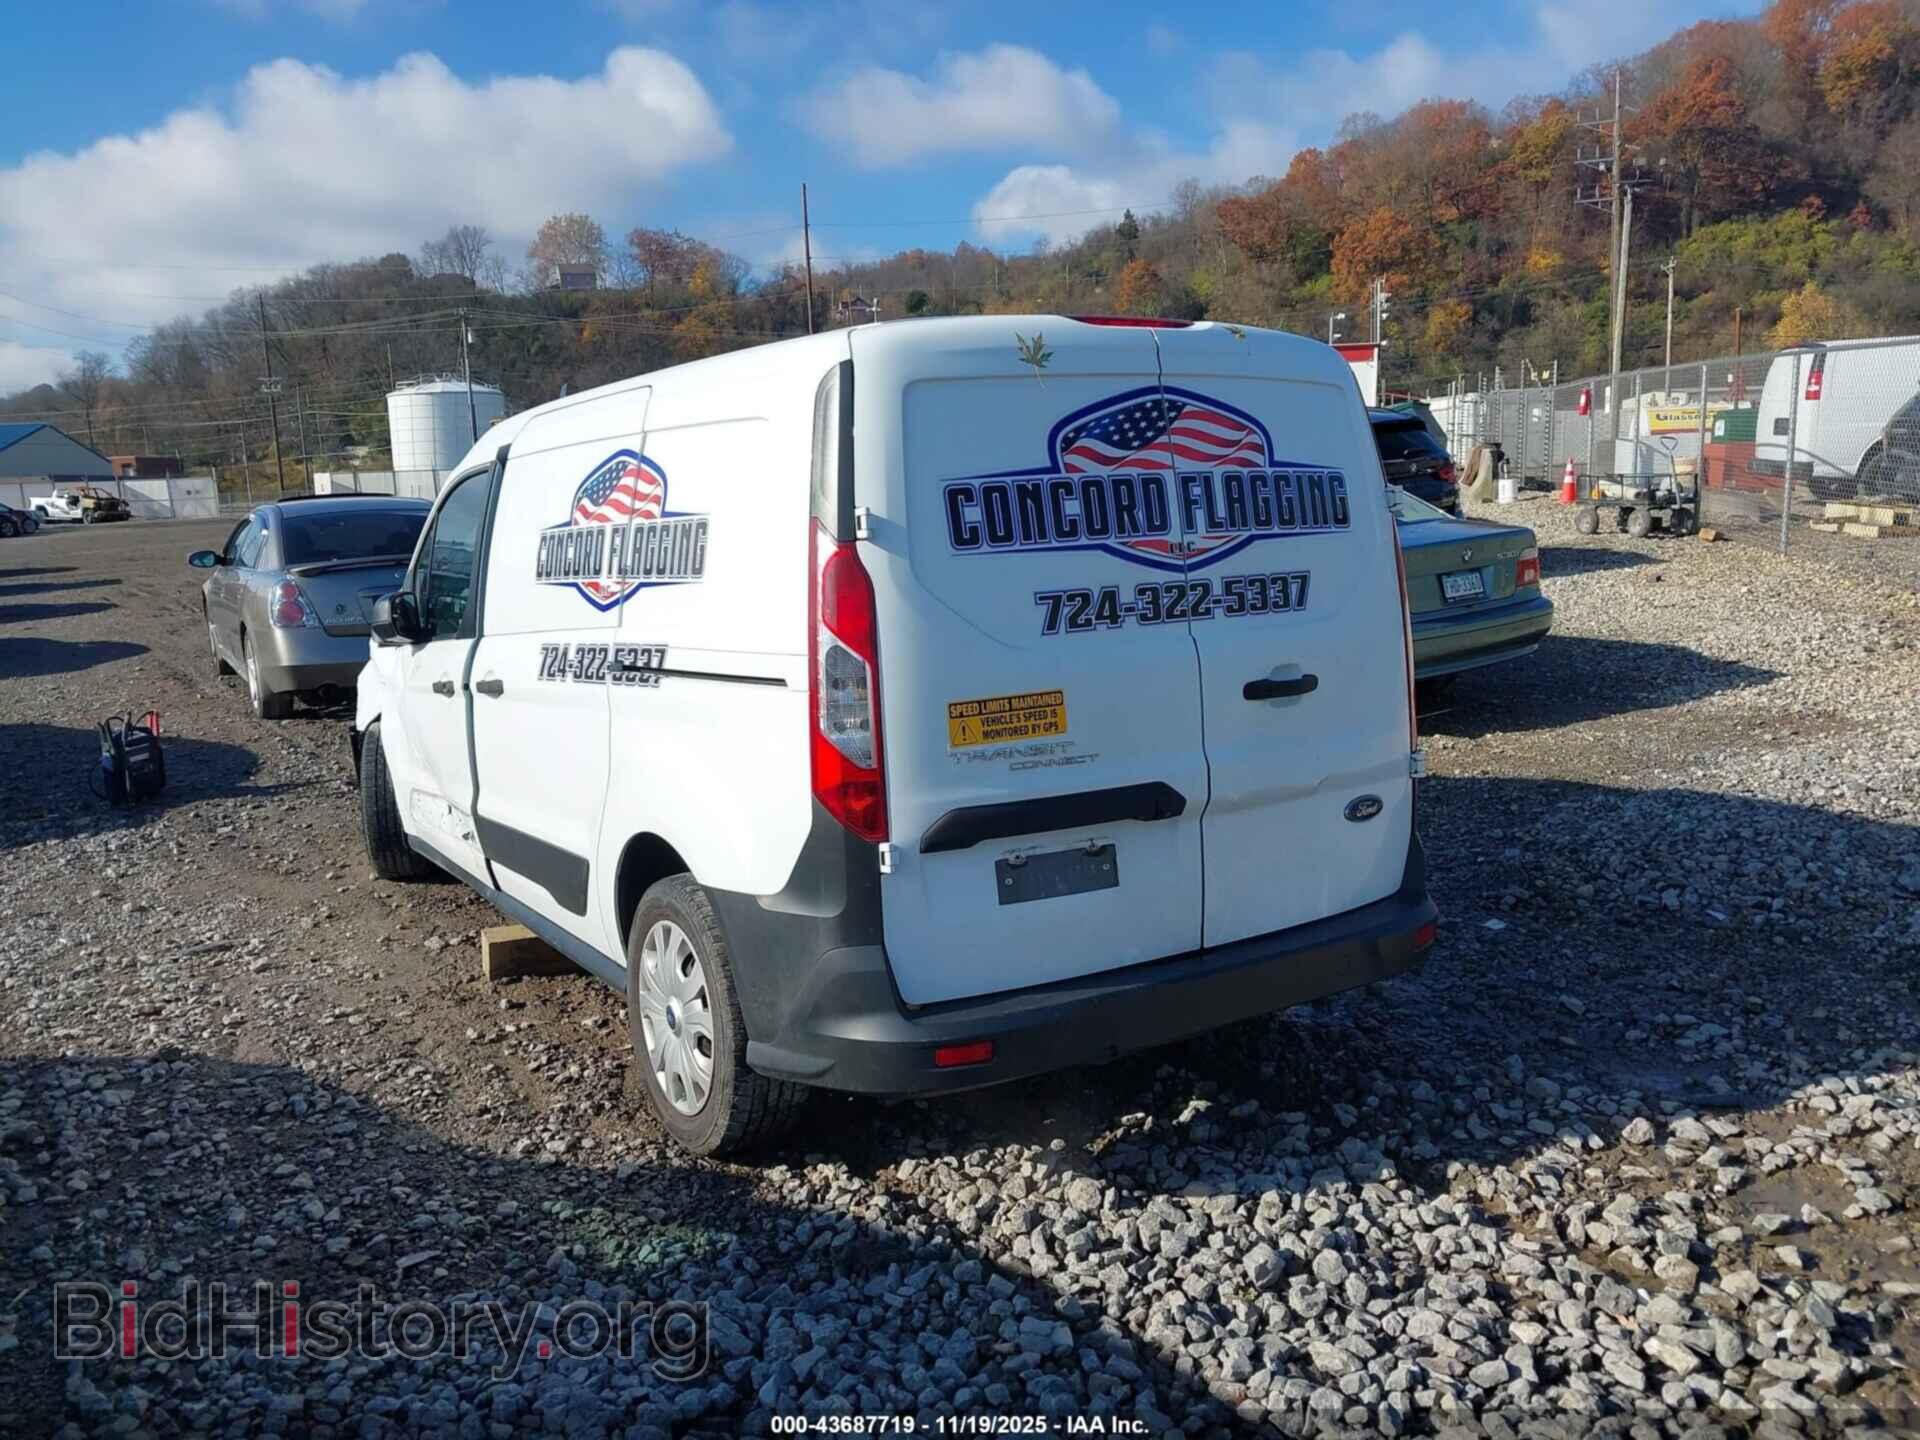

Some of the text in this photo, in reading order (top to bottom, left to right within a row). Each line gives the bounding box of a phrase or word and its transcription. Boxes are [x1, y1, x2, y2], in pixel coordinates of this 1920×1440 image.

[944, 470, 1351, 550] CONCORD FLAGGING
[536, 518, 709, 581] CONCORD FLAGGING
[1034, 570, 1311, 636] 724-322-5337
[950, 692, 1062, 716] SPEED LIMITS MAINTAINED
[981, 708, 1058, 728] VEHICLE'S SPEED IS
[982, 721, 1059, 739] MONITORED BY GPS
[948, 741, 1075, 765] TRANSIT
[1009, 752, 1100, 772] CONNECT
